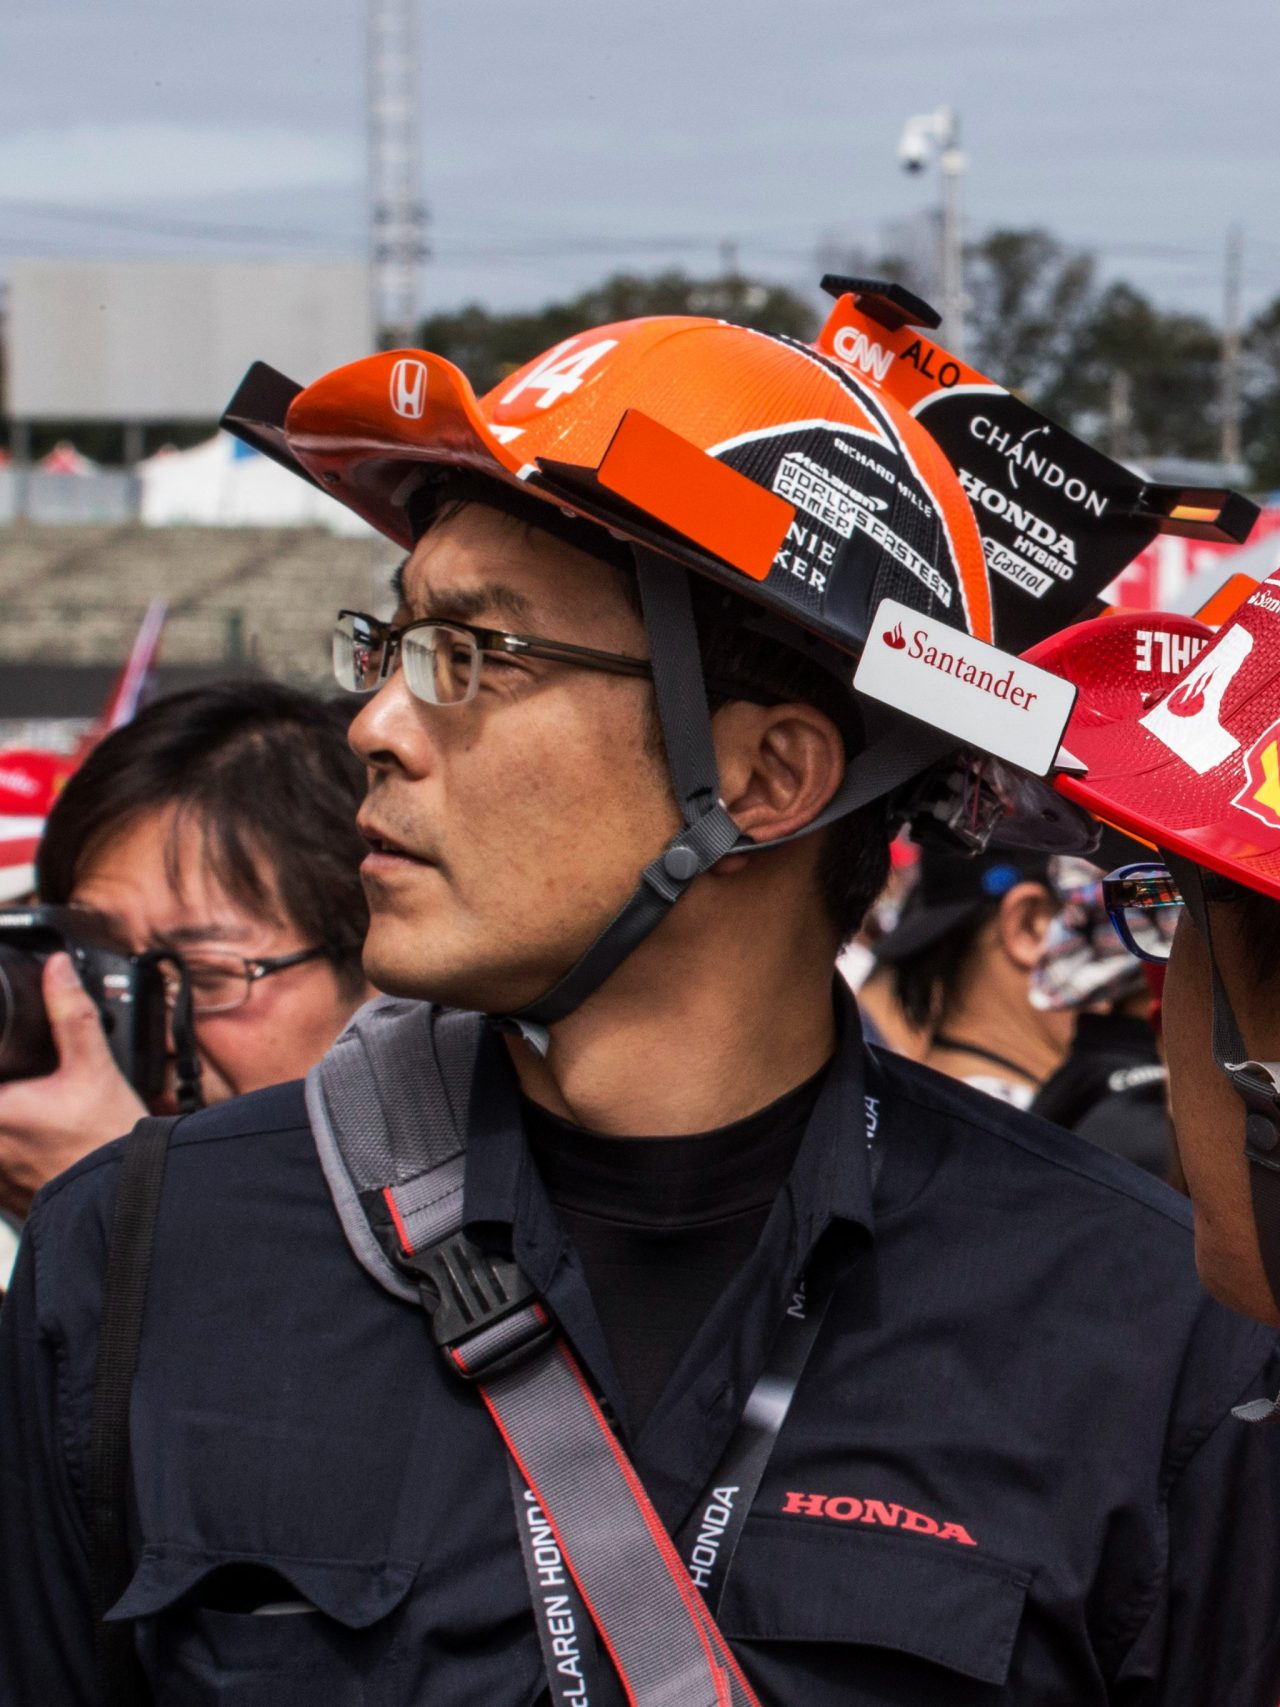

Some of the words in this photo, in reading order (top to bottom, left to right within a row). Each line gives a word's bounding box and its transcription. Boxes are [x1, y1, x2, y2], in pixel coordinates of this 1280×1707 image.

[500, 339, 619, 409] 14
[833, 326, 895, 382] CNN
[899, 339, 961, 388] ALO
[833, 437, 896, 484] RICHARD
[897, 481, 933, 519] MILLE
[969, 416, 1109, 517] CHANDON
[776, 478, 851, 536] GAMER
[959, 468, 1077, 565] HONDA
[773, 547, 827, 592] KER
[870, 525, 951, 602] FASTEST
[992, 551, 1046, 592] Castrol
[1013, 535, 1074, 580] HYBRID
[907, 630, 1038, 712] Santander
[688, 1486, 740, 1588] HONDA
[782, 1491, 978, 1546] HONDA
[543, 1594, 589, 1707] cLAREN
